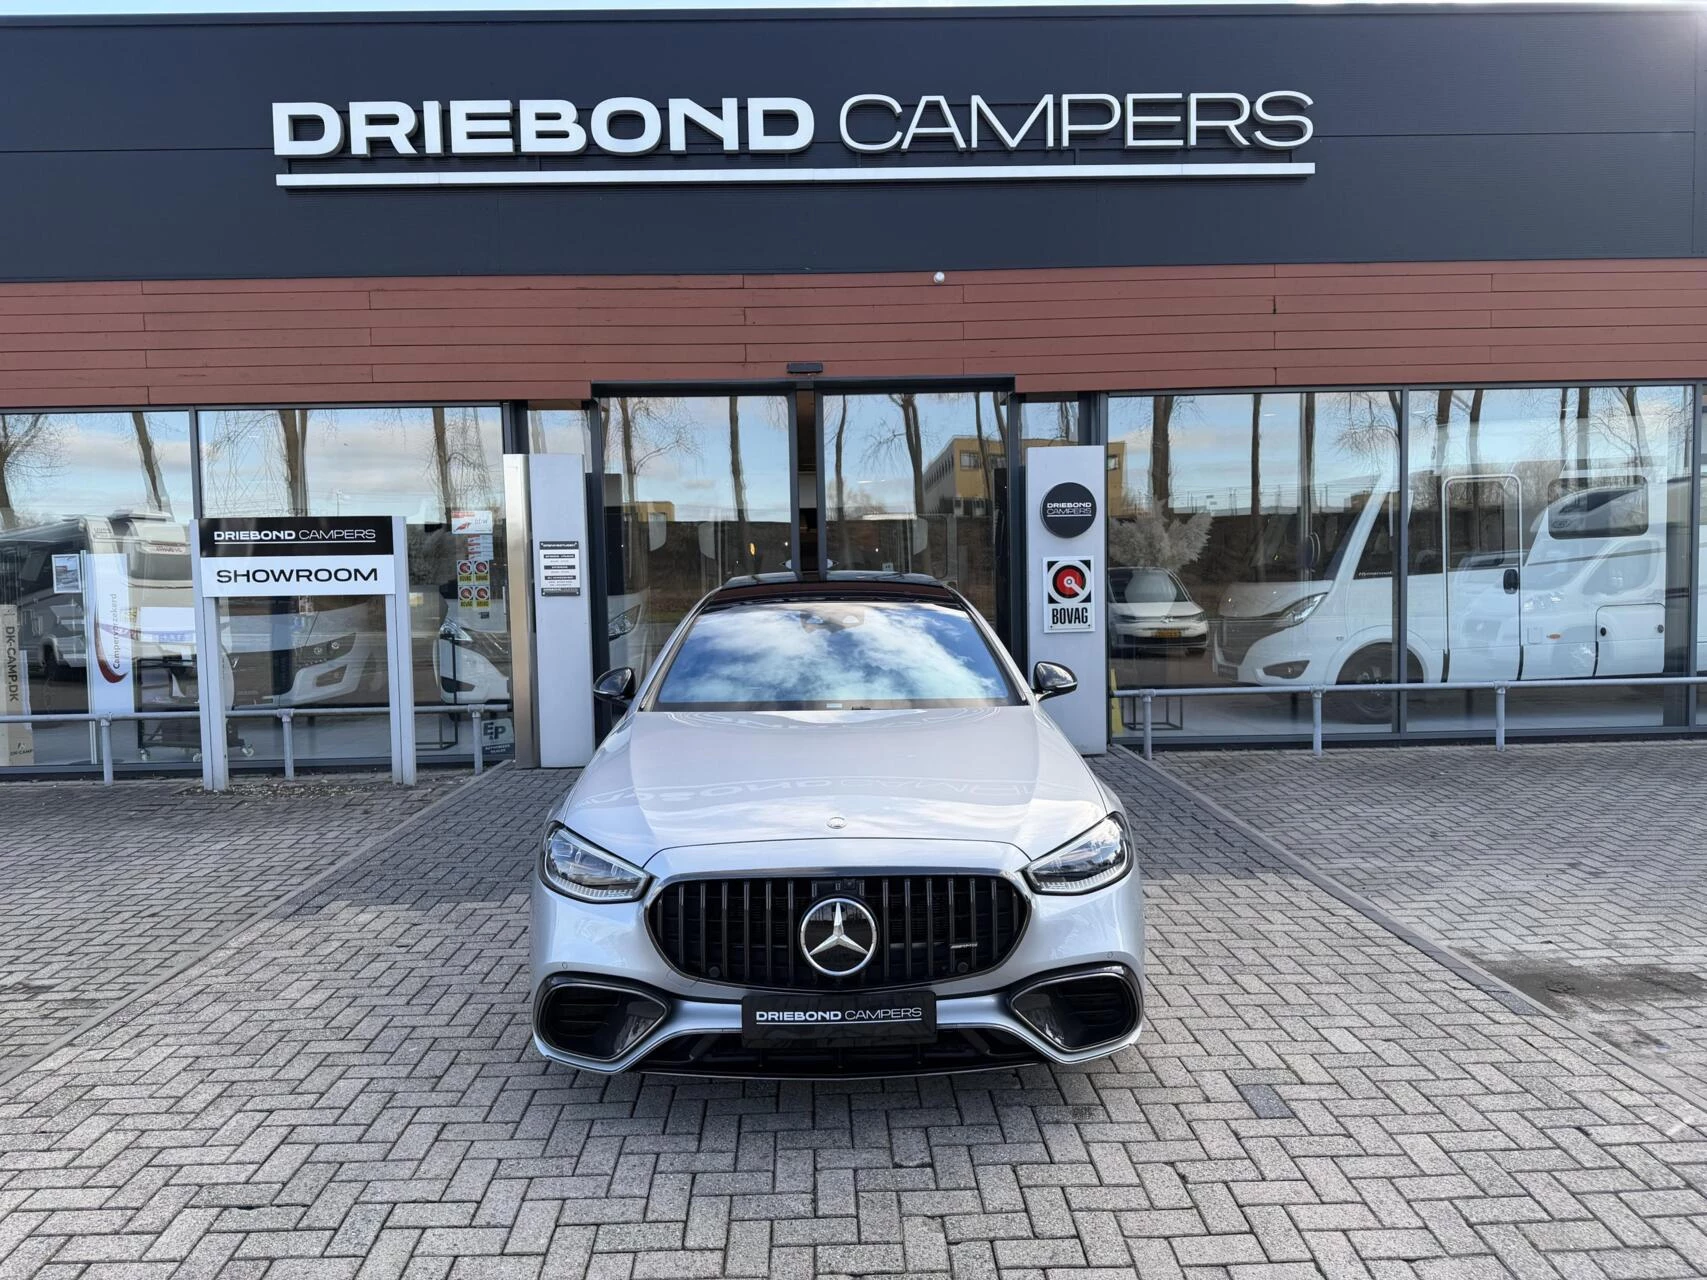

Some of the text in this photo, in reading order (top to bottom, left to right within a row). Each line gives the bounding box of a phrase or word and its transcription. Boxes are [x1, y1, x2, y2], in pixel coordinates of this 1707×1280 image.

[272, 90, 1316, 157] DRIEBOND CAMPERS
[213, 529, 376, 541] DRIEBOND CAMPERS
[216, 567, 378, 584] SHOWROOM
[1052, 607, 1088, 625] BOVAG
[6, 626, 19, 702] DK-CAMP.DK
[756, 1008, 922, 1021] DRIEBOND CAMPERS
